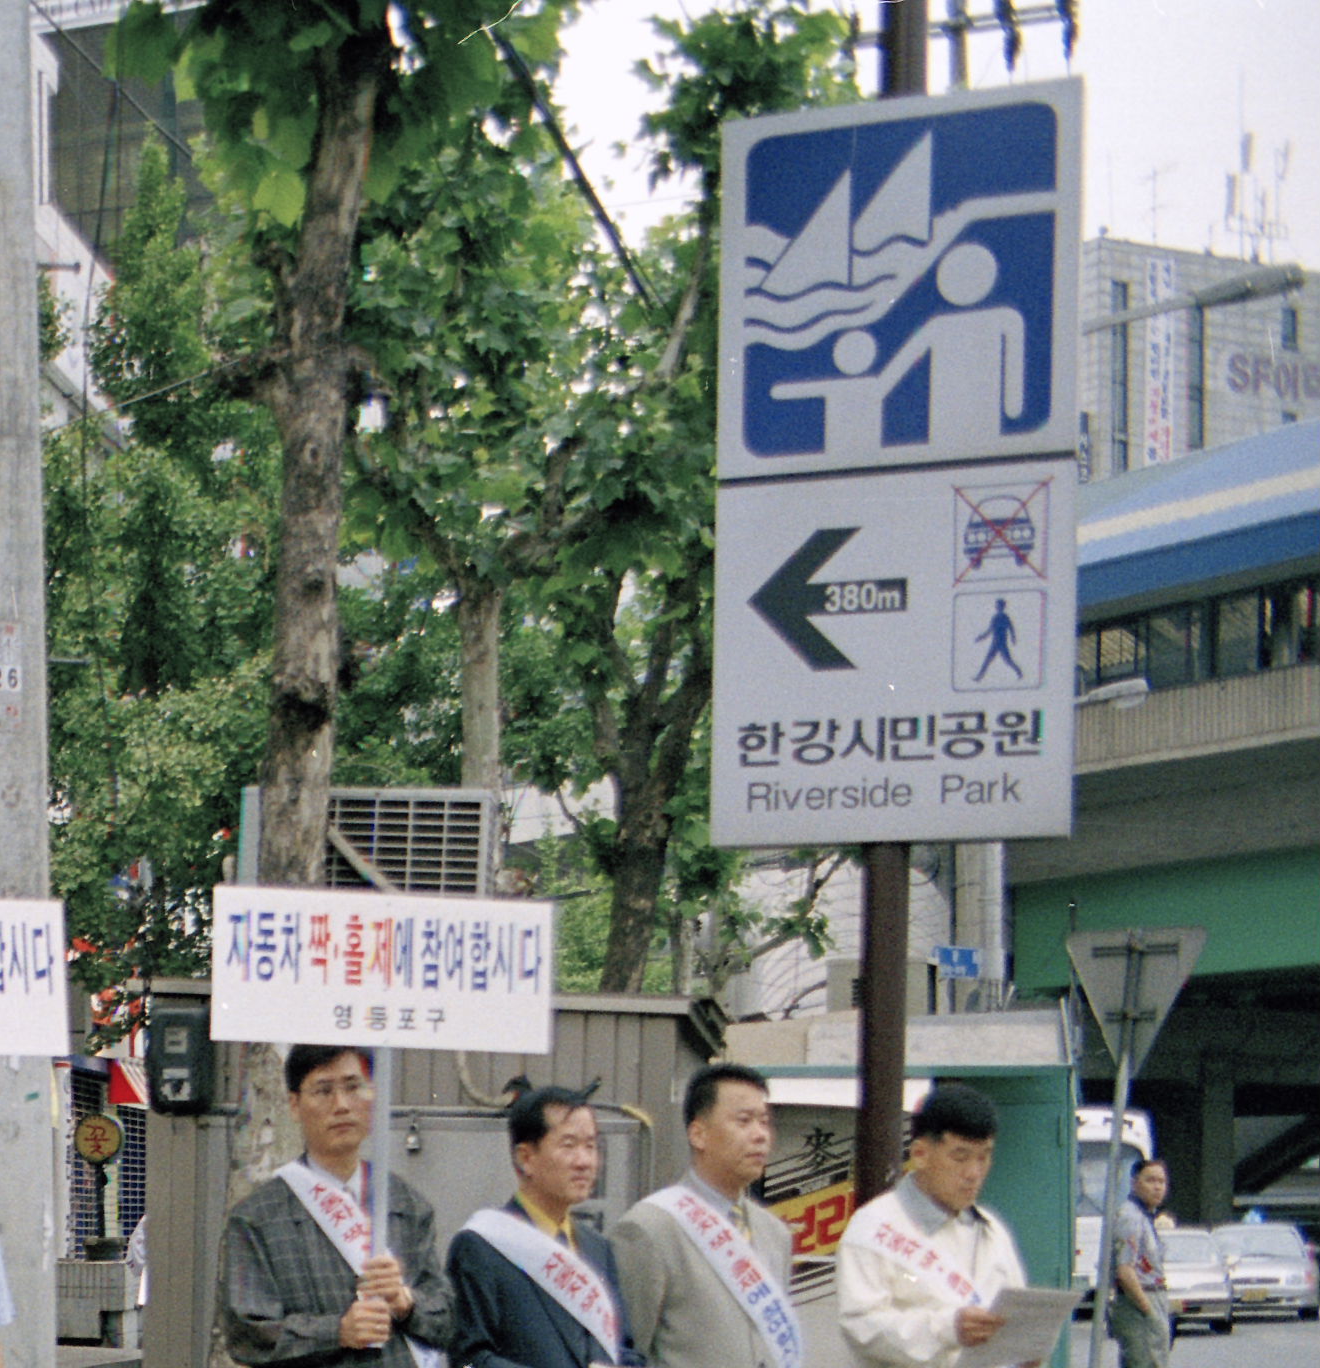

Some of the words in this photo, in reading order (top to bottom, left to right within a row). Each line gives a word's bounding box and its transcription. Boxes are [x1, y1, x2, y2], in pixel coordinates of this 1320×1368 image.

[824, 583, 900, 612] 380m
[738, 709, 1044, 767] 한강시민공원
[748, 777, 913, 813] Riverside
[940, 772, 1021, 805] Park
[226, 909, 302, 985] 자동차
[421, 917, 542, 995] 참여합시다
[333, 1004, 446, 1033] 영등포구
